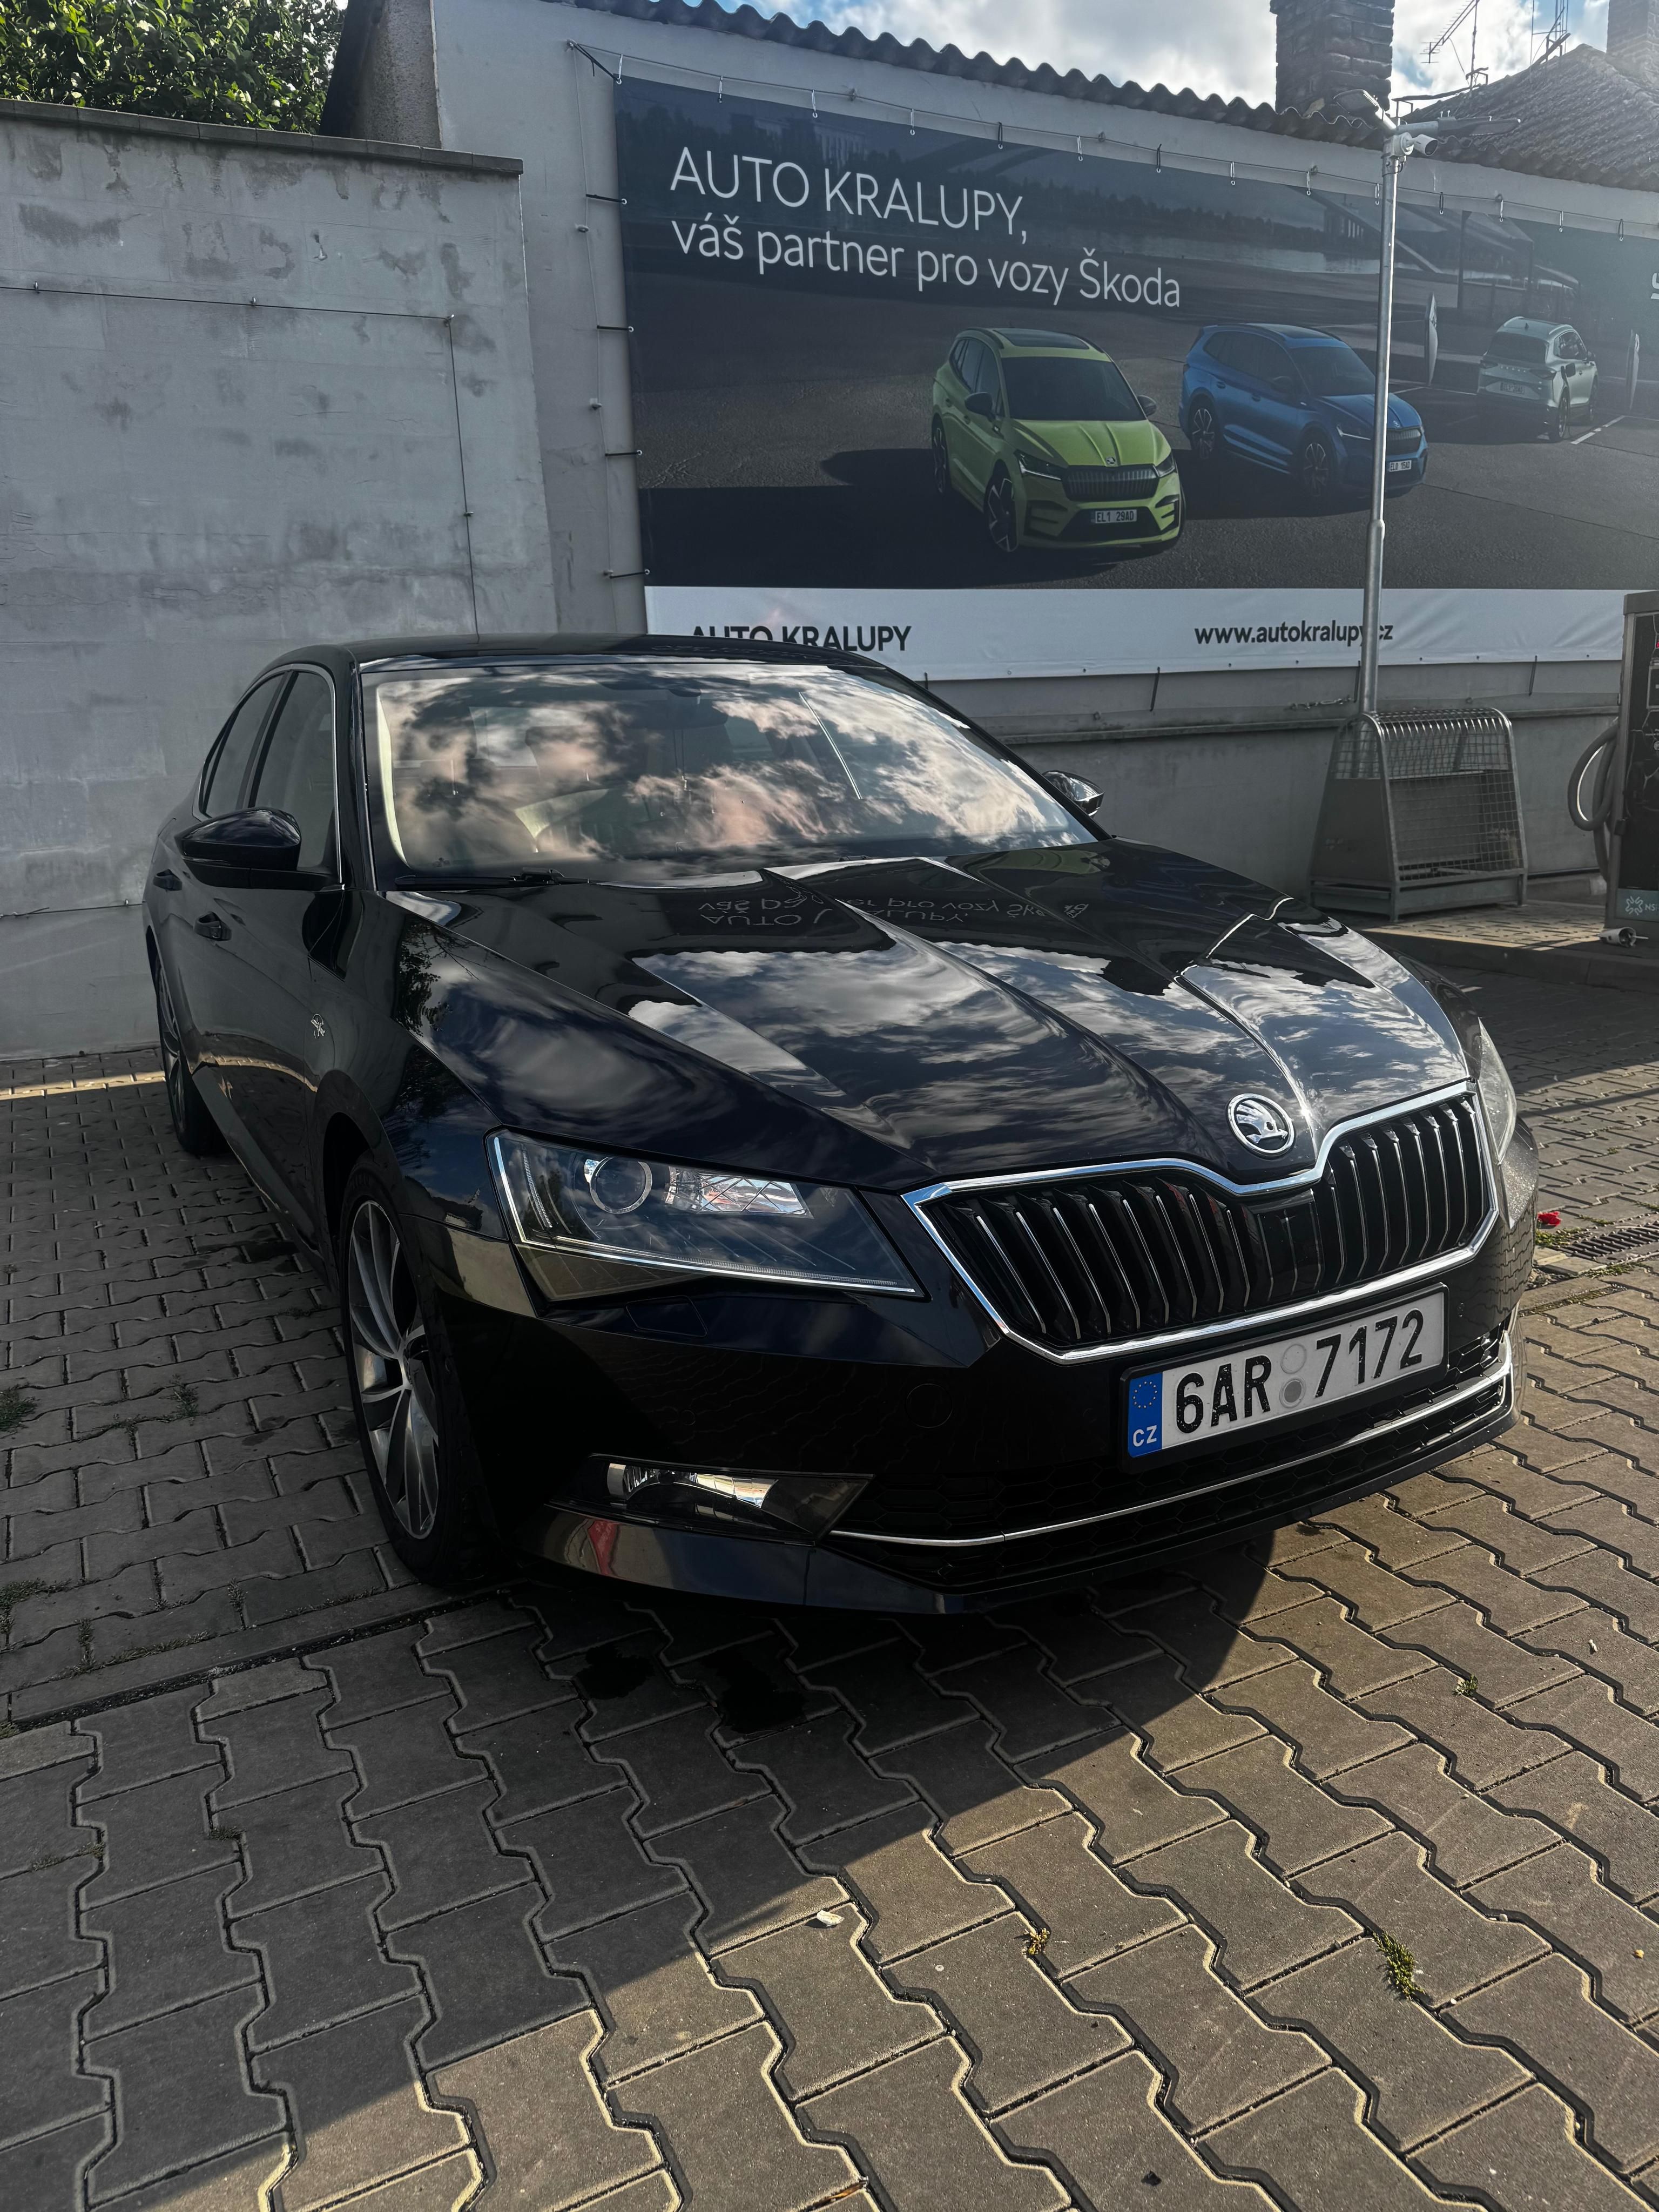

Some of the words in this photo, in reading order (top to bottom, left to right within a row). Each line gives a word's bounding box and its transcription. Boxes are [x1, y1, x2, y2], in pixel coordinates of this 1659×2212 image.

[670, 146, 809, 208] AUTO
[825, 168, 1028, 245] KRALUPY,
[671, 212, 744, 260] váš
[757, 230, 904, 278] partner
[917, 249, 978, 292] pro
[988, 258, 1069, 306] vozy
[1078, 247, 1181, 307] Škoda
[782, 625, 912, 651] KRALUPY
[1176, 1354, 1272, 1434] 6AR
[1314, 1309, 1424, 1398] 7172
[1132, 1425, 1157, 1447] CZ
